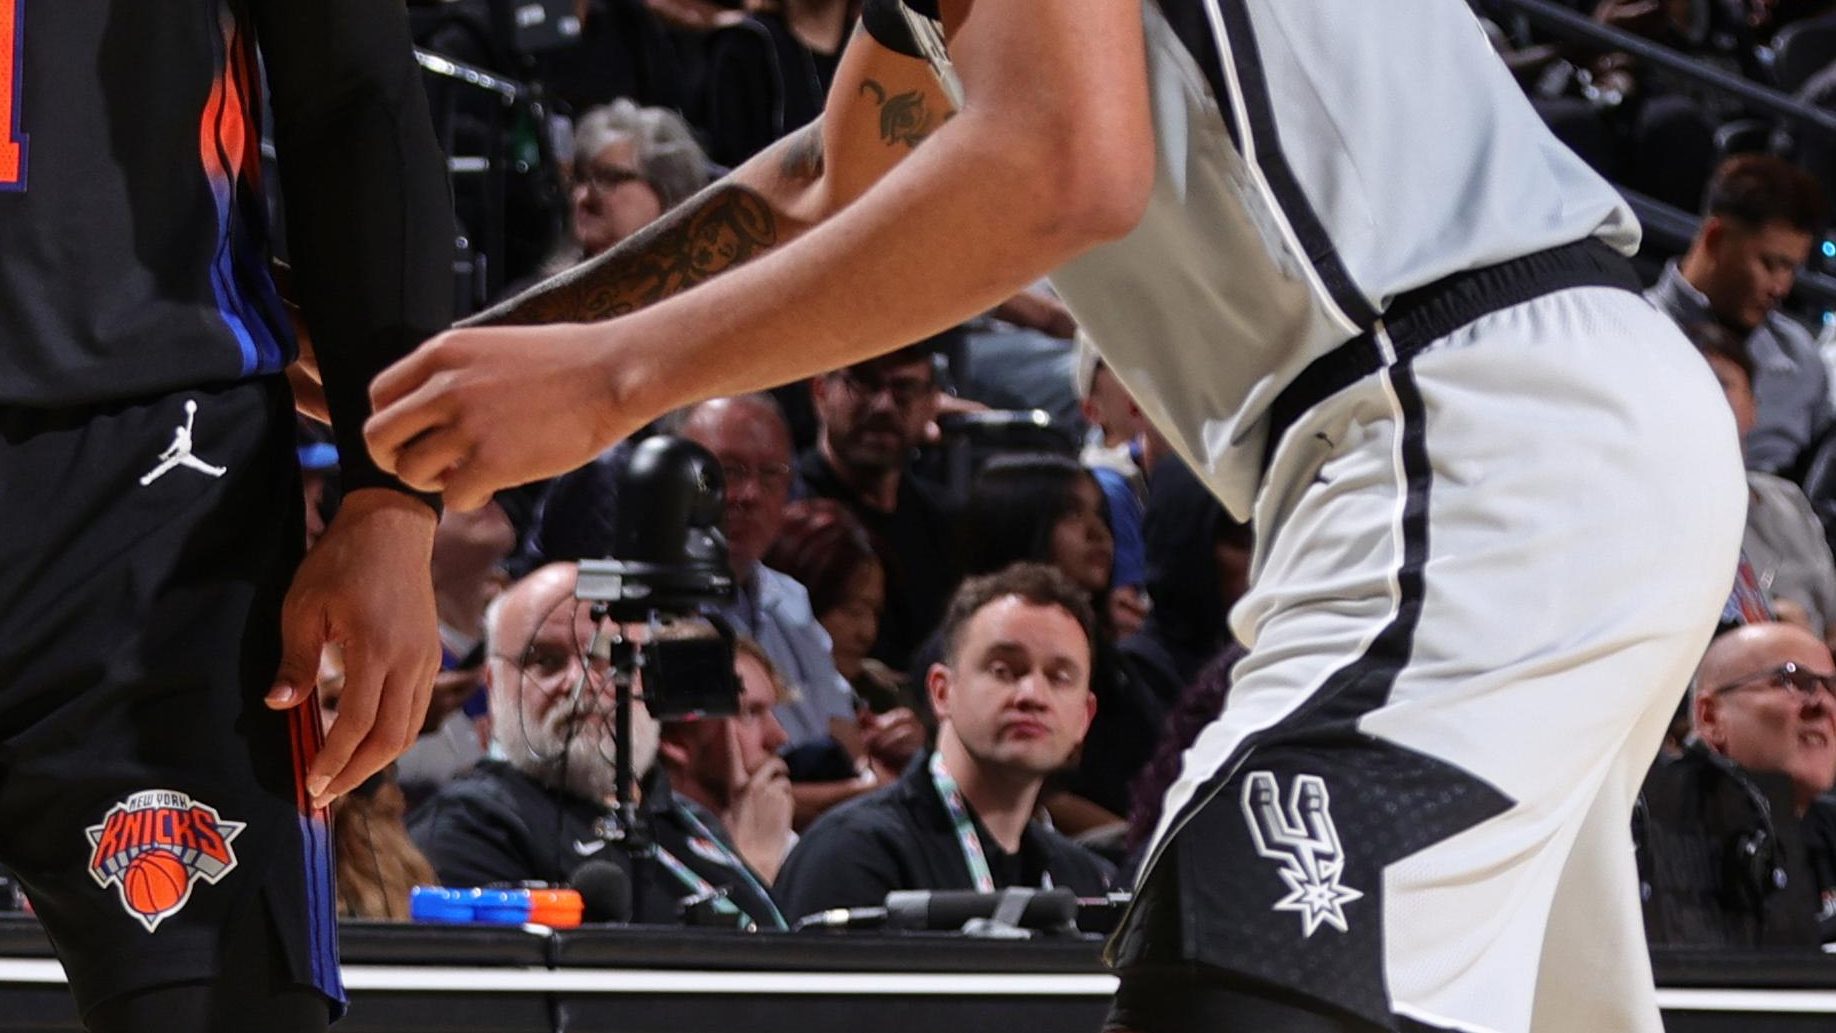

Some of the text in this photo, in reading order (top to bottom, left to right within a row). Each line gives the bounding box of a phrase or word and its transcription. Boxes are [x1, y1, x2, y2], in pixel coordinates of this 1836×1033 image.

[128, 792, 189, 810] NEW YORK
[92, 807, 232, 868] KNICKS
